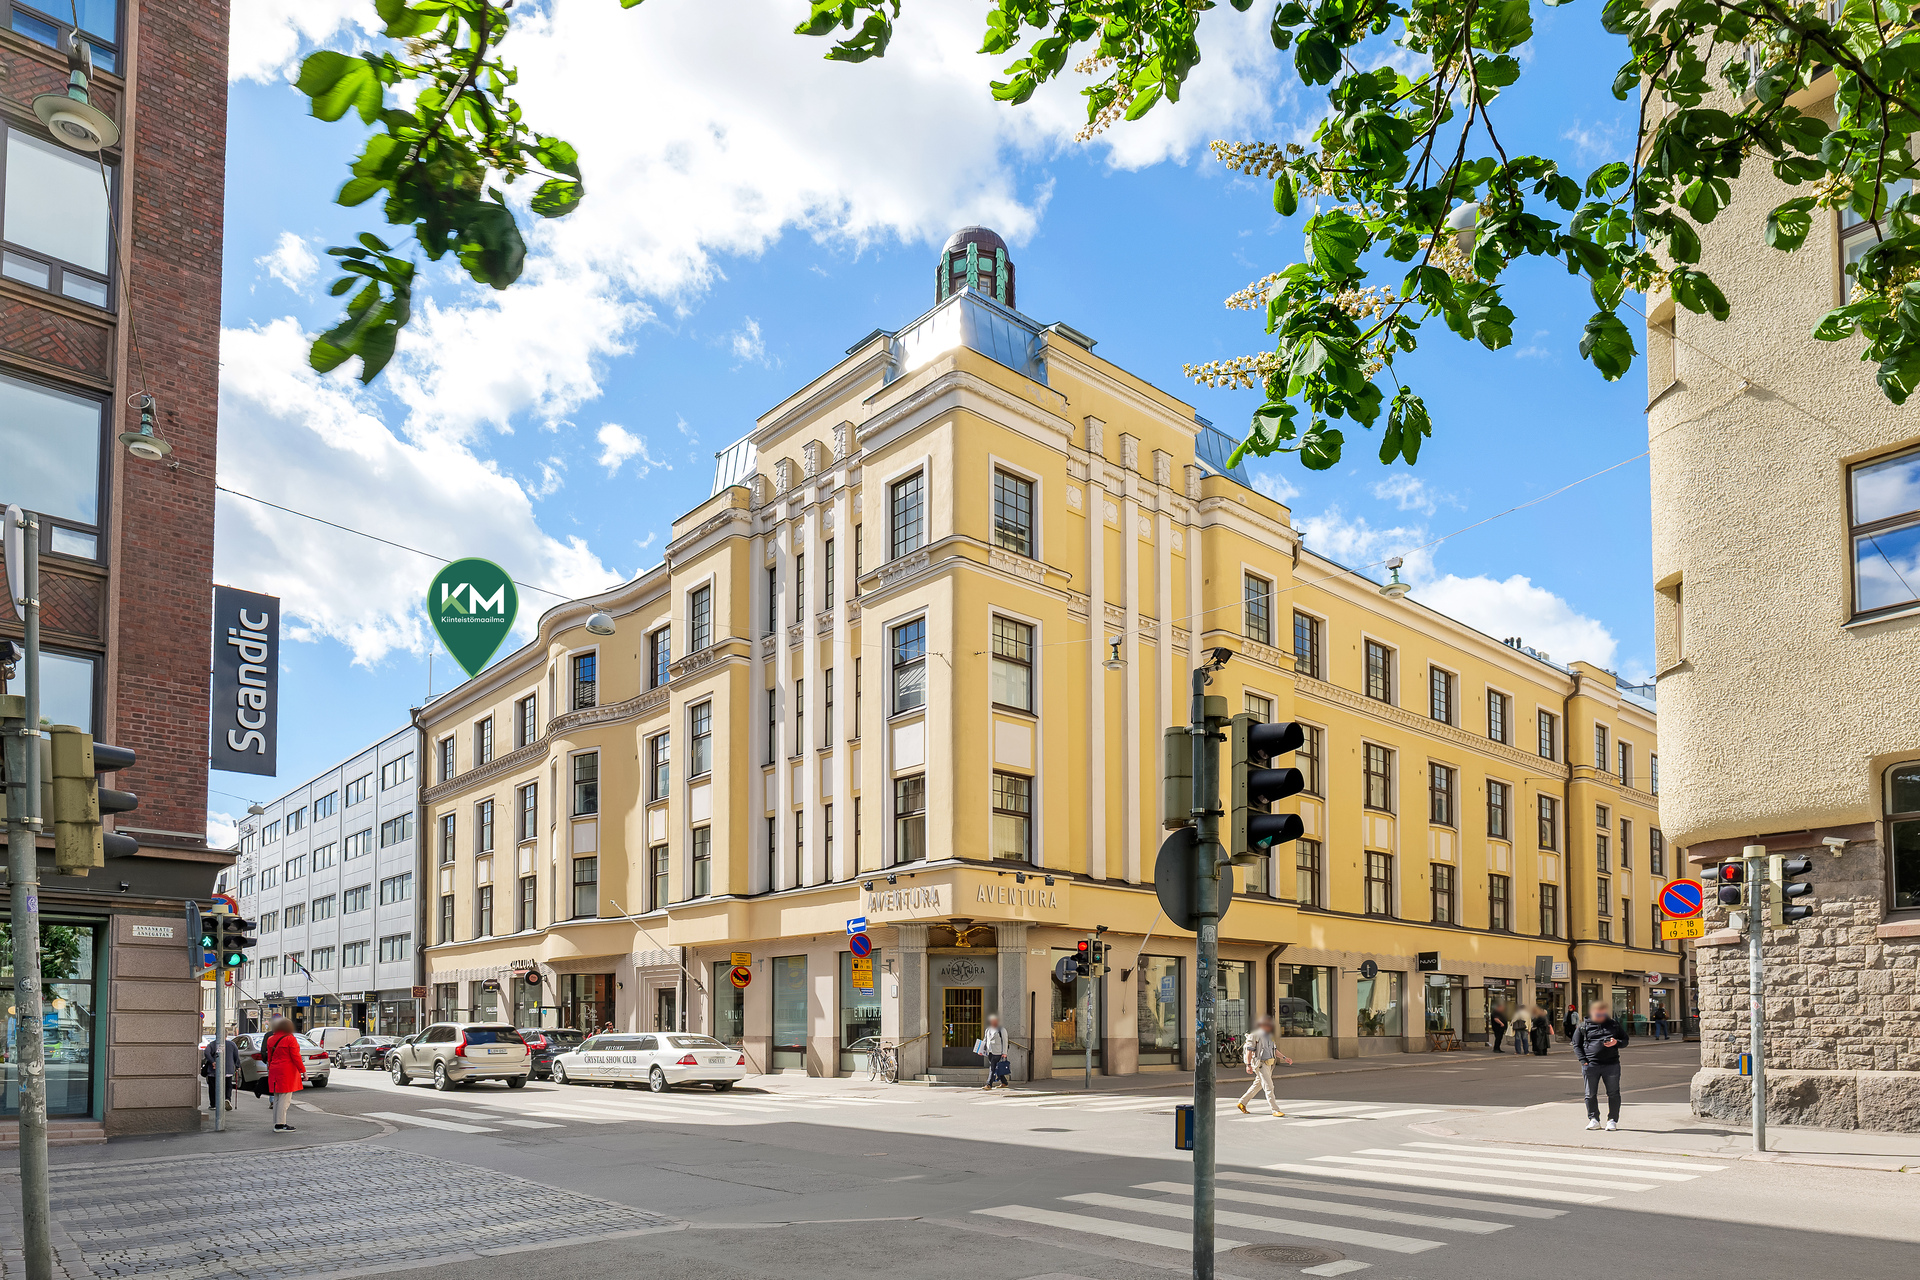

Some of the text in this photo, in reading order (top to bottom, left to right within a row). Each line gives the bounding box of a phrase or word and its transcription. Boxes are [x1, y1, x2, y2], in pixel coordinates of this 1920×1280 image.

[228, 608, 269, 755] Scandic
[867, 886, 937, 910] AVENTURA
[976, 884, 1057, 909] AVENTURA
[1673, 921, 1678, 929] 7
[1686, 920, 1695, 928] 18
[1669, 930, 1678, 938] (9
[1686, 929, 1698, 937] 15)
[510, 958, 536, 969] CHALUPA
[584, 1055, 637, 1064] CRYSTAL SHOW CLUB
